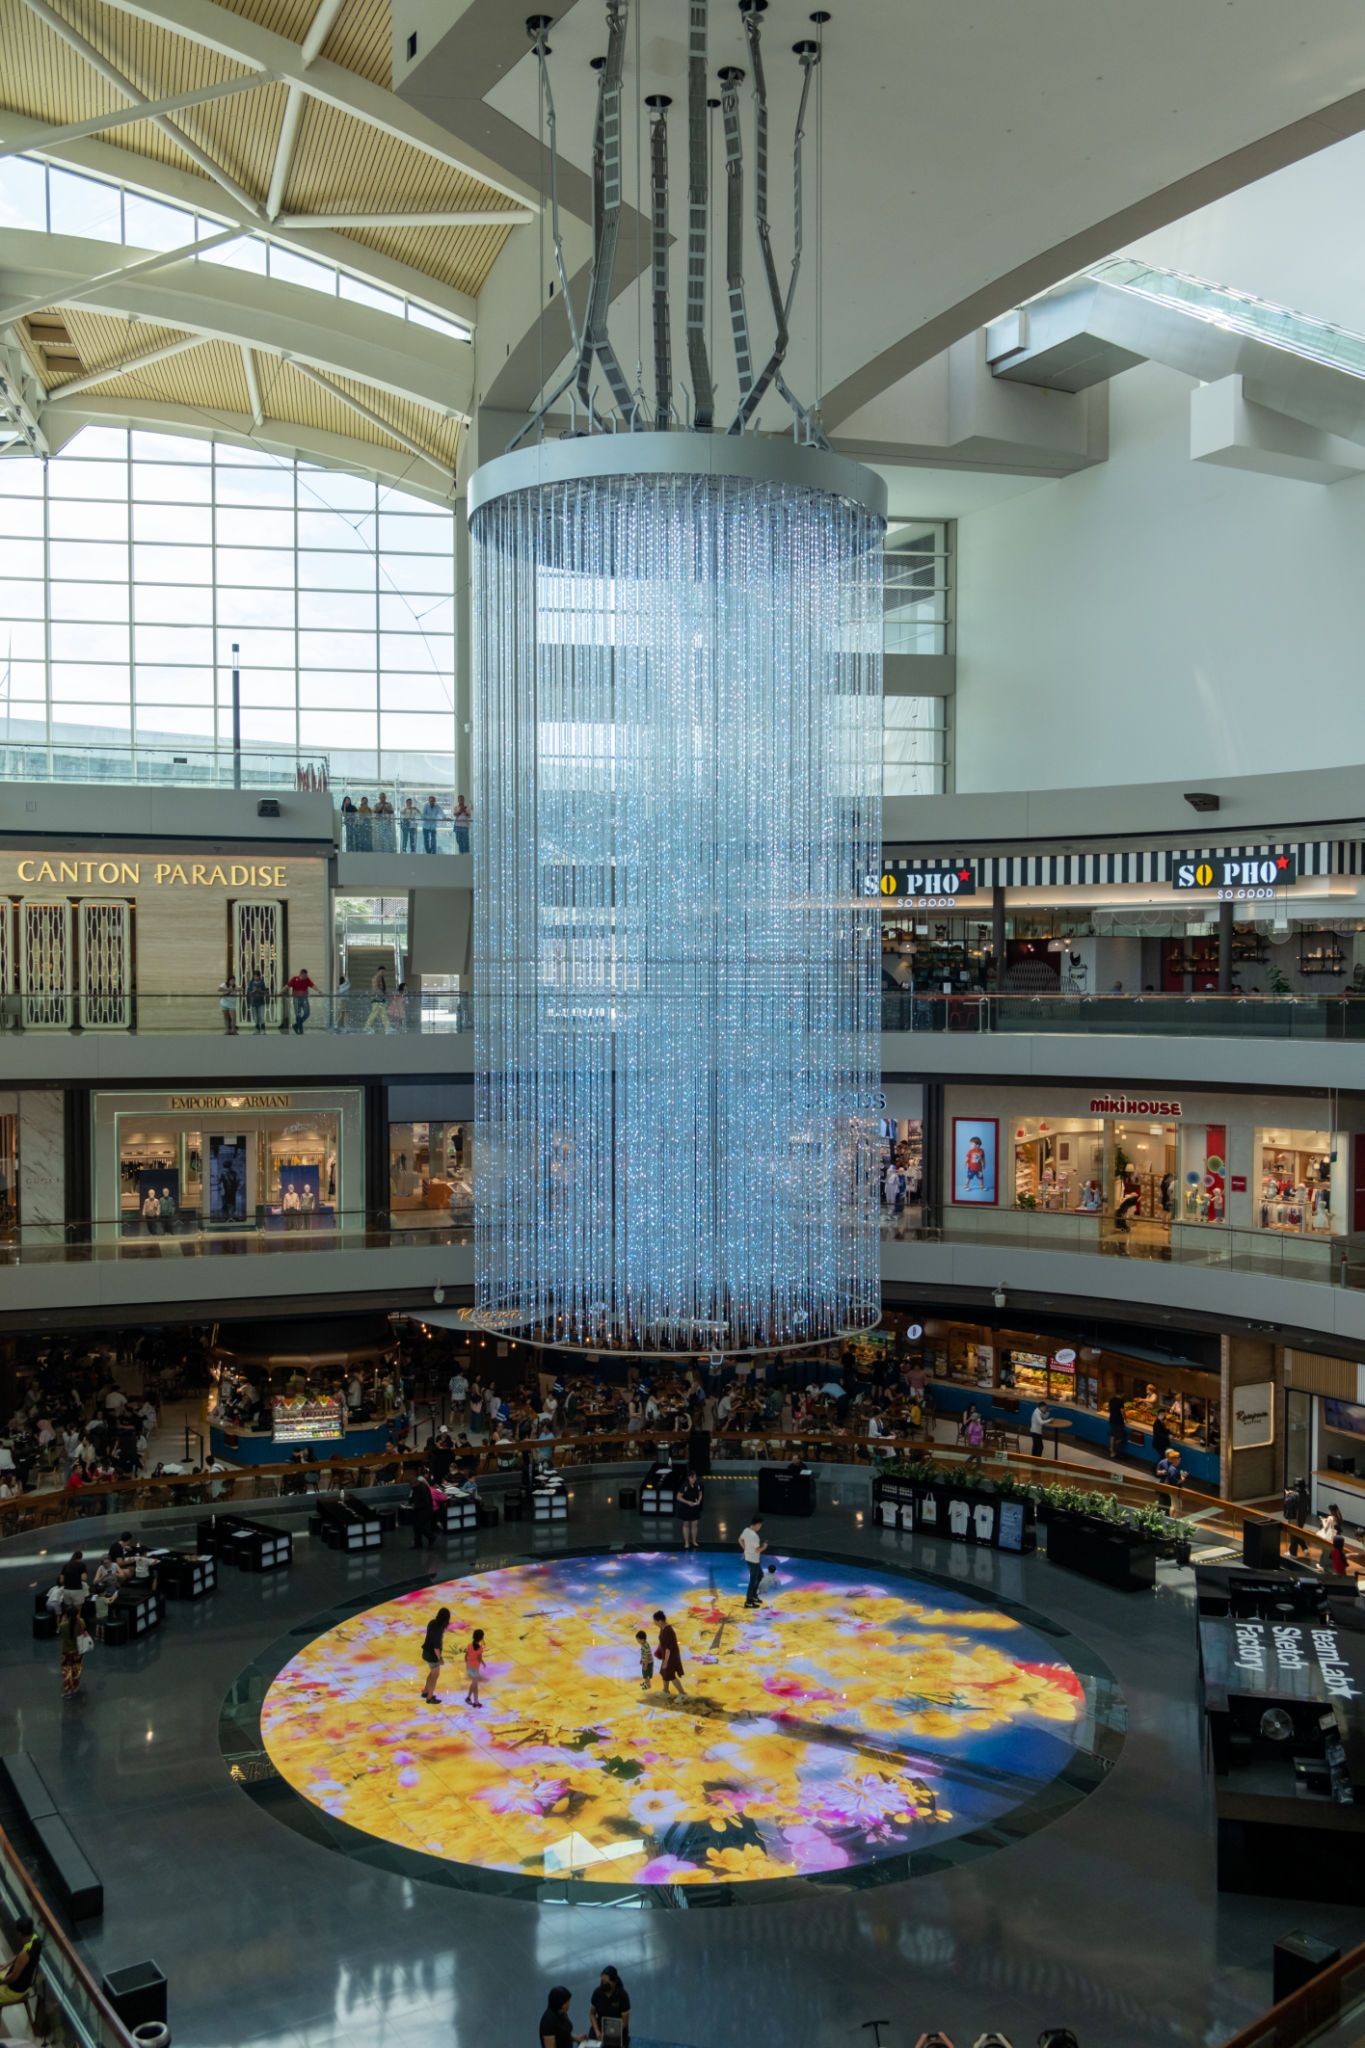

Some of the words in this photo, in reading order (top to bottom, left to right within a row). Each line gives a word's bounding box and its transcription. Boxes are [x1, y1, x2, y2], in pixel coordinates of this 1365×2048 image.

[17, 861, 141, 884] CANTON
[154, 864, 288, 887] PARADISE
[863, 874, 897, 896] SO
[906, 873, 960, 895] PHO
[1178, 864, 1213, 887] SO
[1223, 861, 1277, 885] PHO
[896, 899, 913, 908] SO
[918, 898, 956, 908] GOOD
[1217, 889, 1233, 900] SO
[1236, 888, 1275, 899] GOOD
[171, 1097, 227, 1109] EMPORIO
[243, 1095, 289, 1108] ARMANI
[1233, 1622, 1267, 1672] Factory
[1271, 1625, 1310, 1670] Sketch
[1310, 1628, 1355, 1690] teamLab
